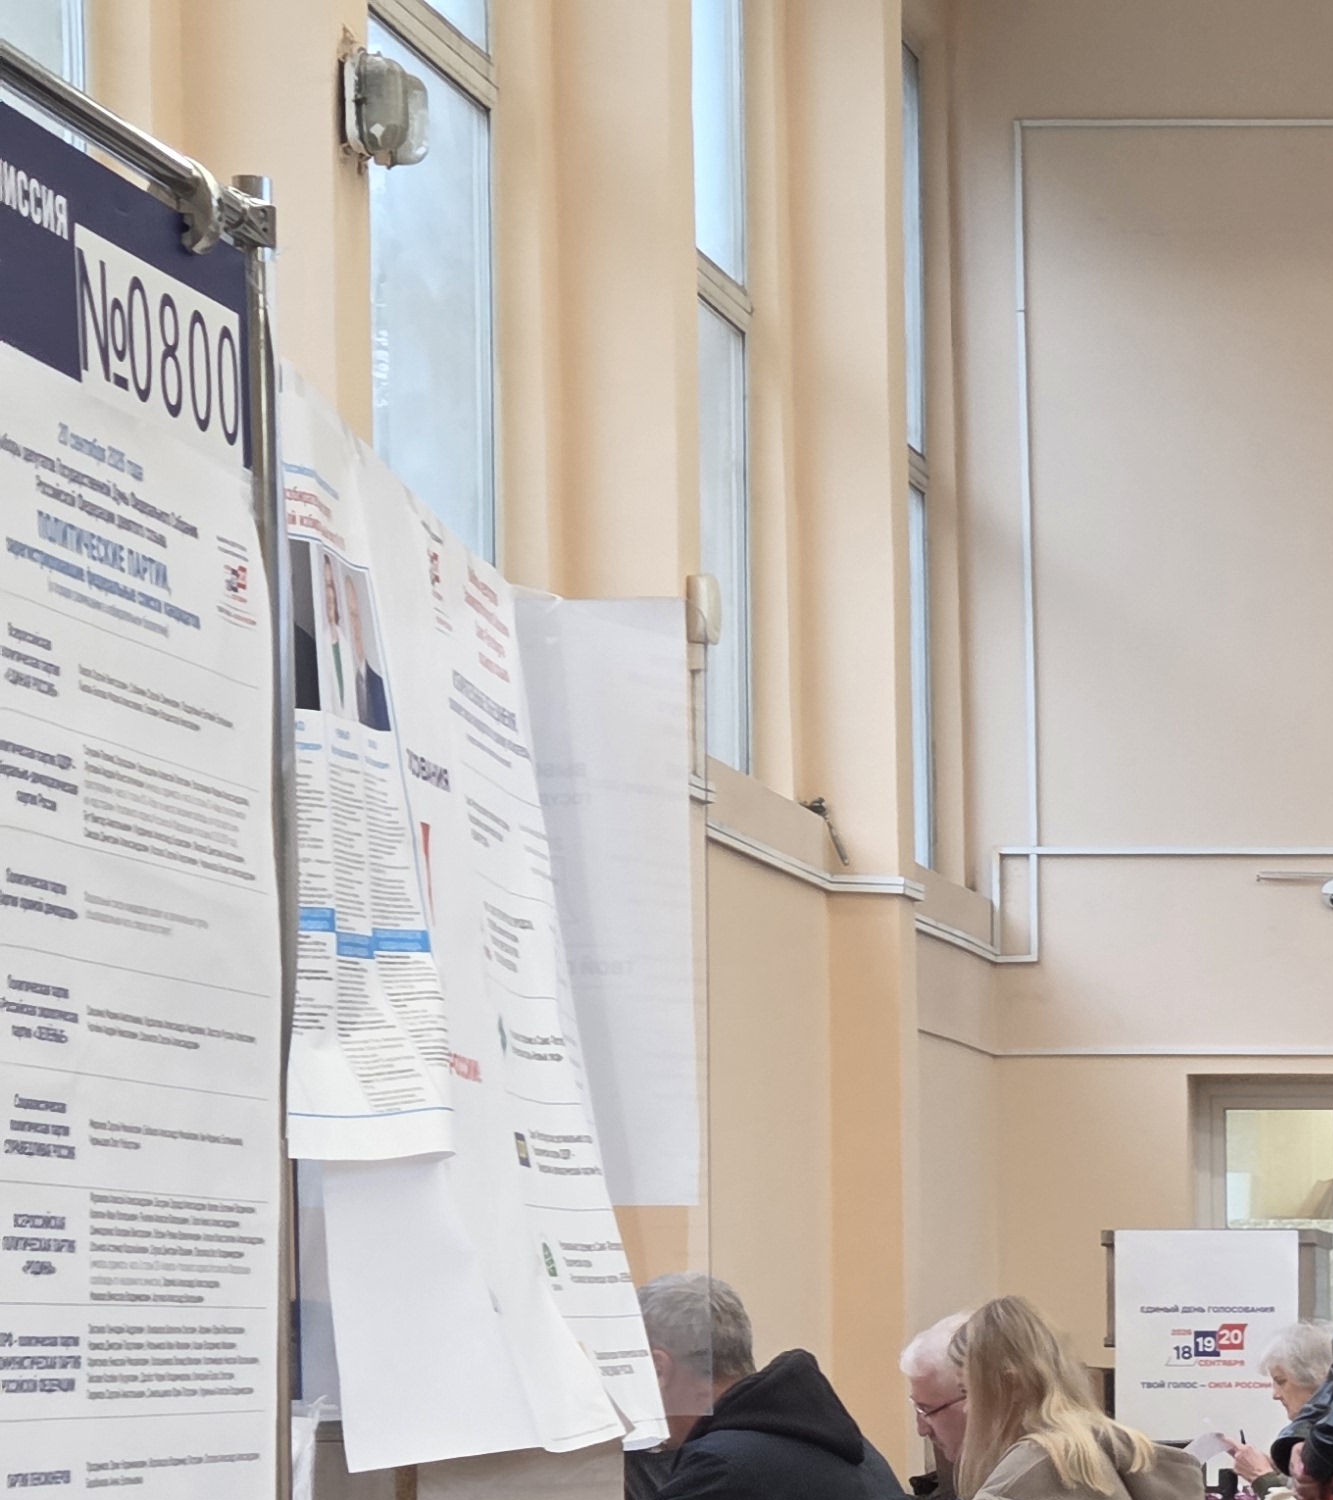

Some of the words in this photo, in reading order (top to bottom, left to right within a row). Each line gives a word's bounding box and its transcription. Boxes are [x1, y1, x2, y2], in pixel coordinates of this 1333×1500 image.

[0, 157, 69, 240] ИССИЯ
[1140, 1305, 1179, 1313] ЕДИНЫЙ
[1173, 1345, 1193, 1360] 18
[1196, 1336, 1216, 1352] 19
[1219, 1329, 1242, 1345] 20
[1140, 1380, 1166, 1389] ТВОЙ
